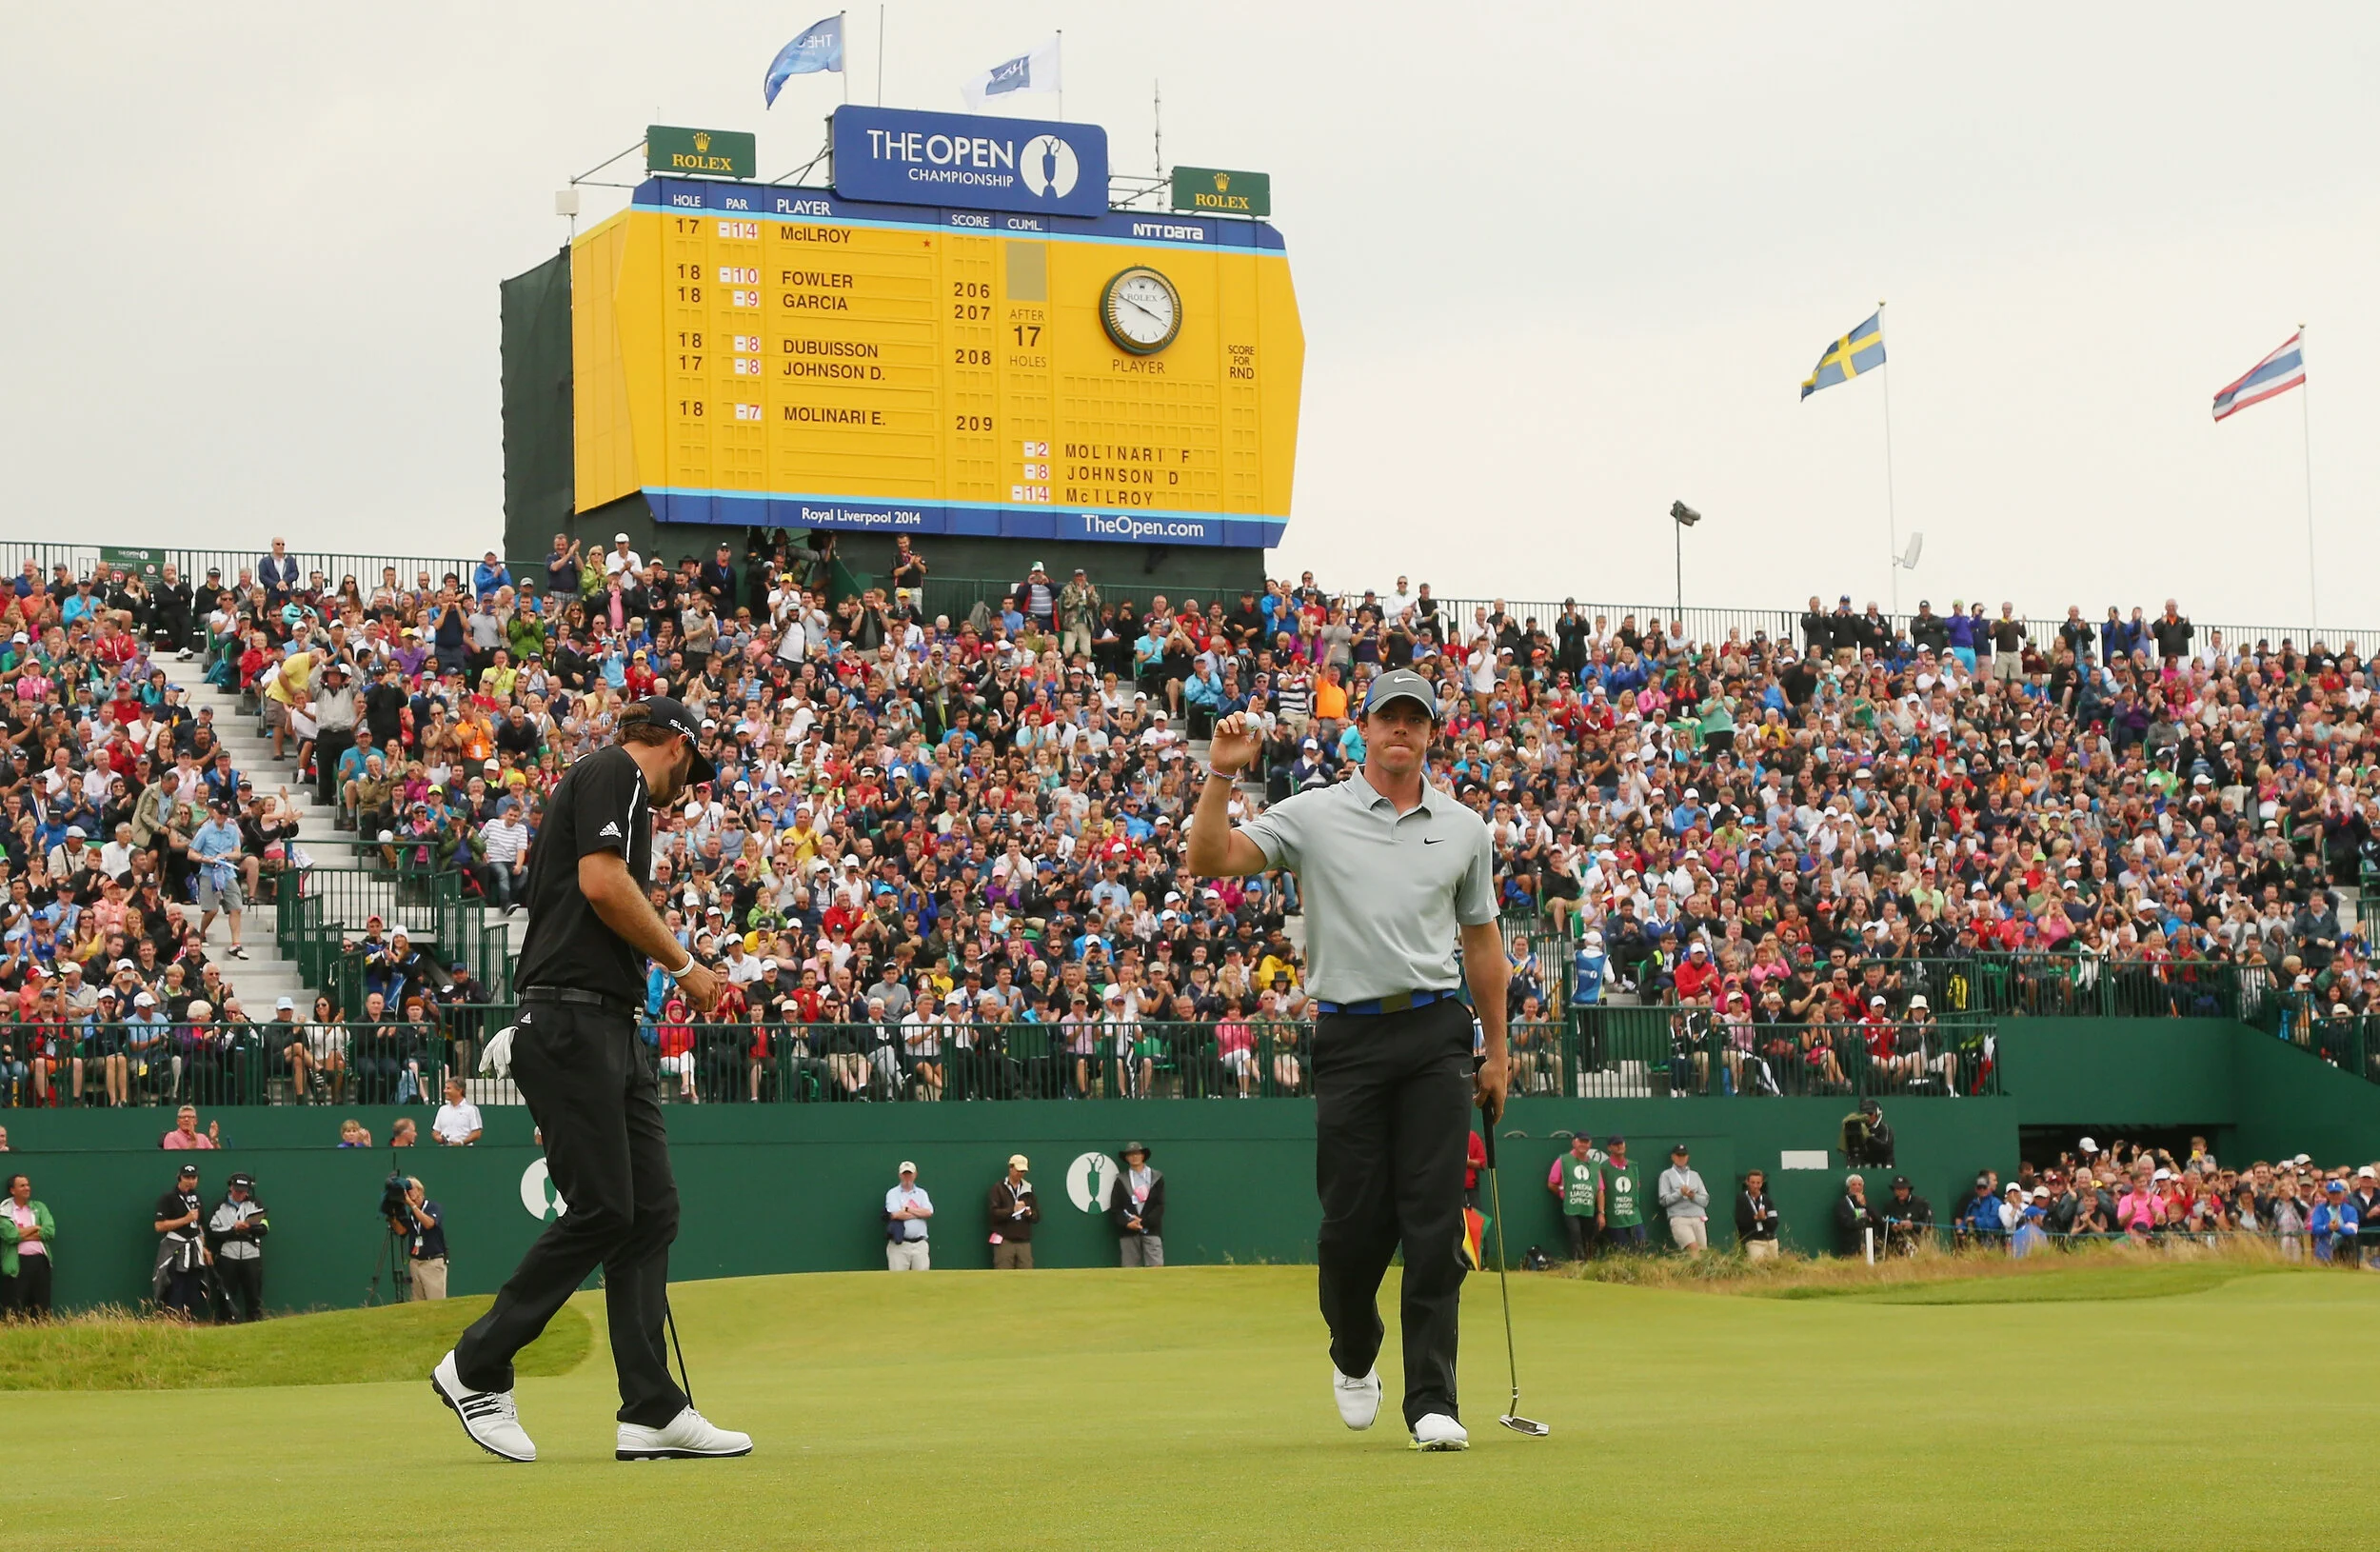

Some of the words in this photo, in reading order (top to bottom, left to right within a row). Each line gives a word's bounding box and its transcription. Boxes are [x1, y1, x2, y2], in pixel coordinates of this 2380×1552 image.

[866, 129, 922, 163] THE
[925, 134, 1013, 169] OPEN
[672, 153, 733, 171] ROLEX
[908, 169, 1014, 188] CHAMPIONSHIP
[1195, 193, 1249, 209] ROLEX
[673, 194, 701, 208] HOLE
[725, 197, 748, 210] PAR
[777, 199, 831, 216] PLAYER
[952, 214, 990, 228] SCORE
[676, 219, 700, 234] 17
[721, 223, 758, 238] -14
[781, 227, 851, 244] McILROY
[678, 264, 701, 280] 18
[722, 268, 758, 284] -10
[782, 271, 853, 289] FOWLER
[954, 282, 990, 299] 206
[678, 287, 701, 303] 18
[736, 290, 758, 307] -9
[783, 294, 848, 310] GARCIA
[954, 305, 991, 321] 207
[1127, 293, 1158, 302] ROLEX
[1010, 309, 1044, 321] AFTER
[1014, 325, 1041, 347] 17
[679, 332, 702, 348] 18
[737, 336, 759, 351] -8
[783, 340, 878, 358] DUBUISSON
[955, 349, 991, 365] 208
[1228, 345, 1254, 355] SCORE
[679, 355, 703, 371] 17
[737, 359, 760, 374] -8
[783, 362, 864, 379] JOHNSON
[870, 367, 885, 381] D.
[1009, 356, 1046, 368] HOLES
[1113, 359, 1165, 374] PLAYER
[1234, 356, 1250, 366] FOR
[1229, 368, 1254, 380] RND
[680, 401, 704, 416] 18
[738, 405, 760, 420] -7
[784, 407, 865, 425] MOLINARI
[872, 411, 885, 426] E.
[956, 415, 993, 431] 209
[1026, 442, 1047, 457] -2
[1065, 444, 1162, 462] MOLINARI
[1181, 450, 1190, 463] F
[1027, 465, 1048, 479] -8
[1067, 467, 1153, 484] JOHNSON
[1169, 472, 1179, 485] D
[1015, 487, 1049, 502] -14
[802, 507, 834, 524] Royal
[838, 510, 891, 525] Liverpool
[894, 511, 922, 524] 2014
[1081, 514, 1204, 539] TheOpen.com
